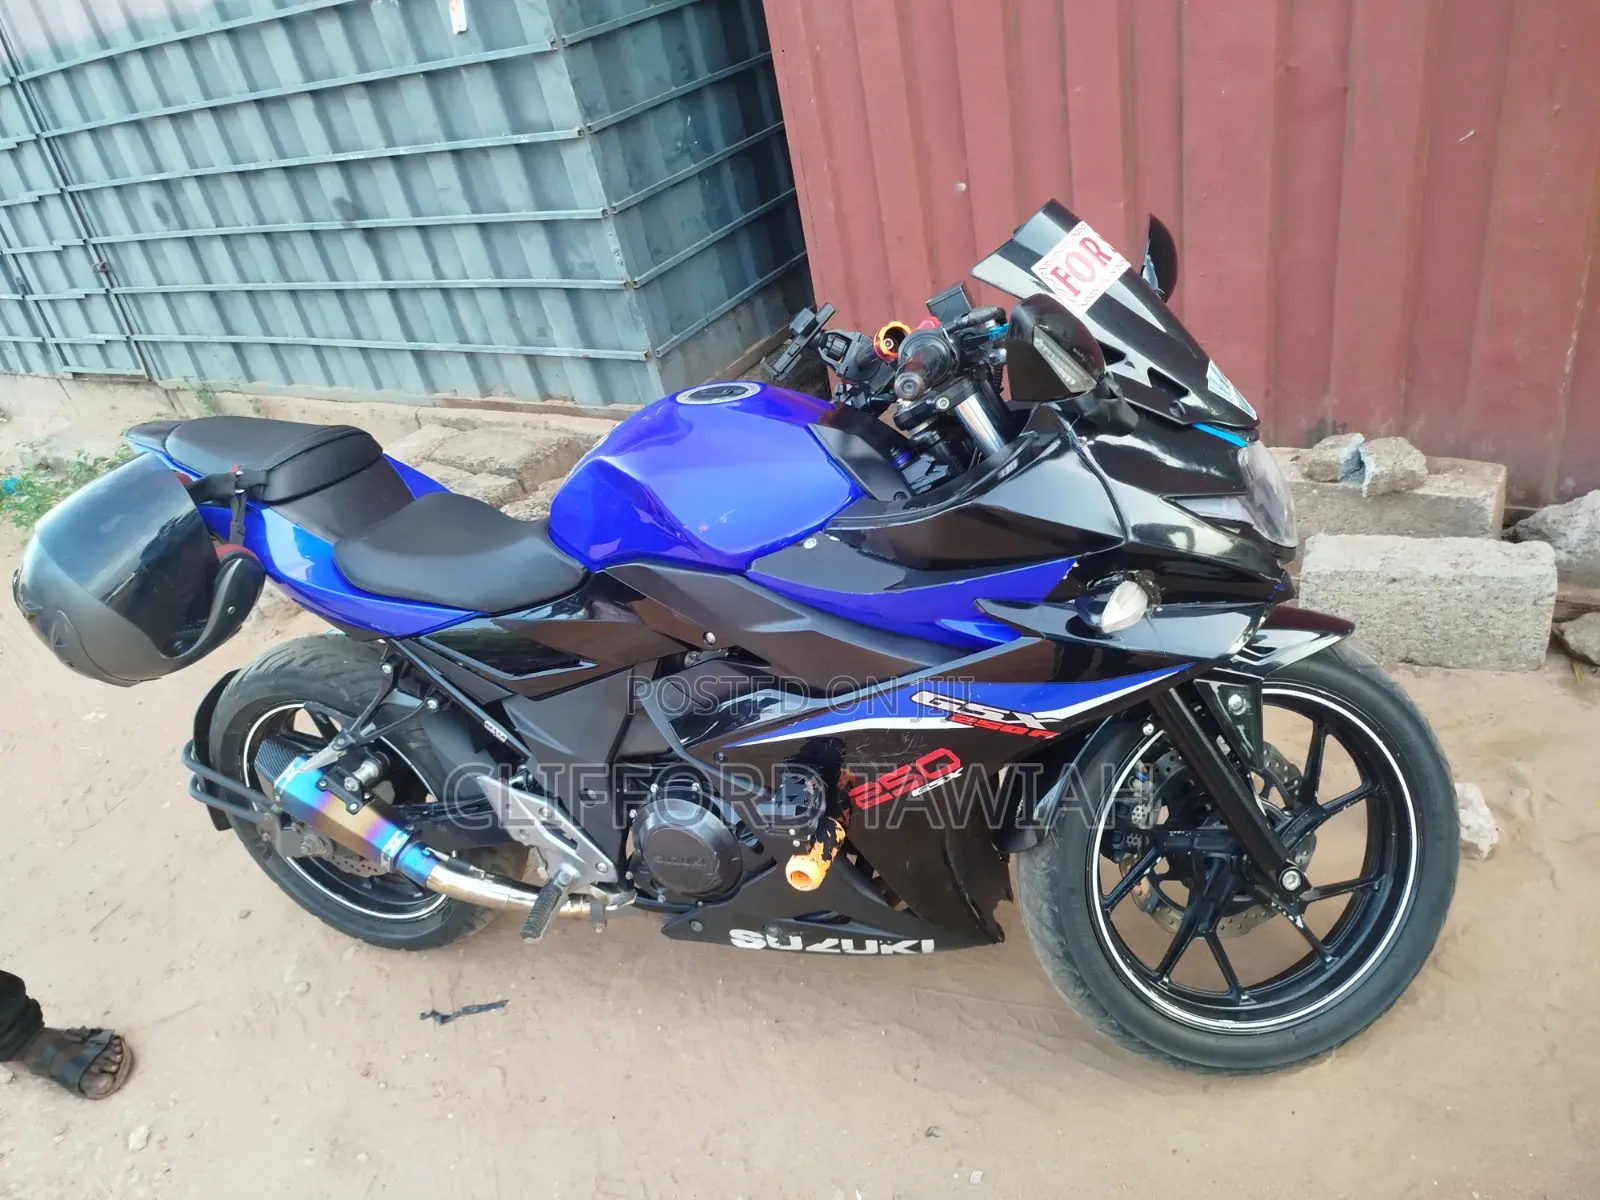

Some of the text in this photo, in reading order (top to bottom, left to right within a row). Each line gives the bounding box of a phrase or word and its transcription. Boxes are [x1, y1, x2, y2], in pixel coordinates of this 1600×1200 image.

[1050, 237, 1112, 297] FOR
[911, 690, 1062, 730] GSX
[849, 748, 961, 810] 250
[729, 929, 935, 955] SUZUKI
